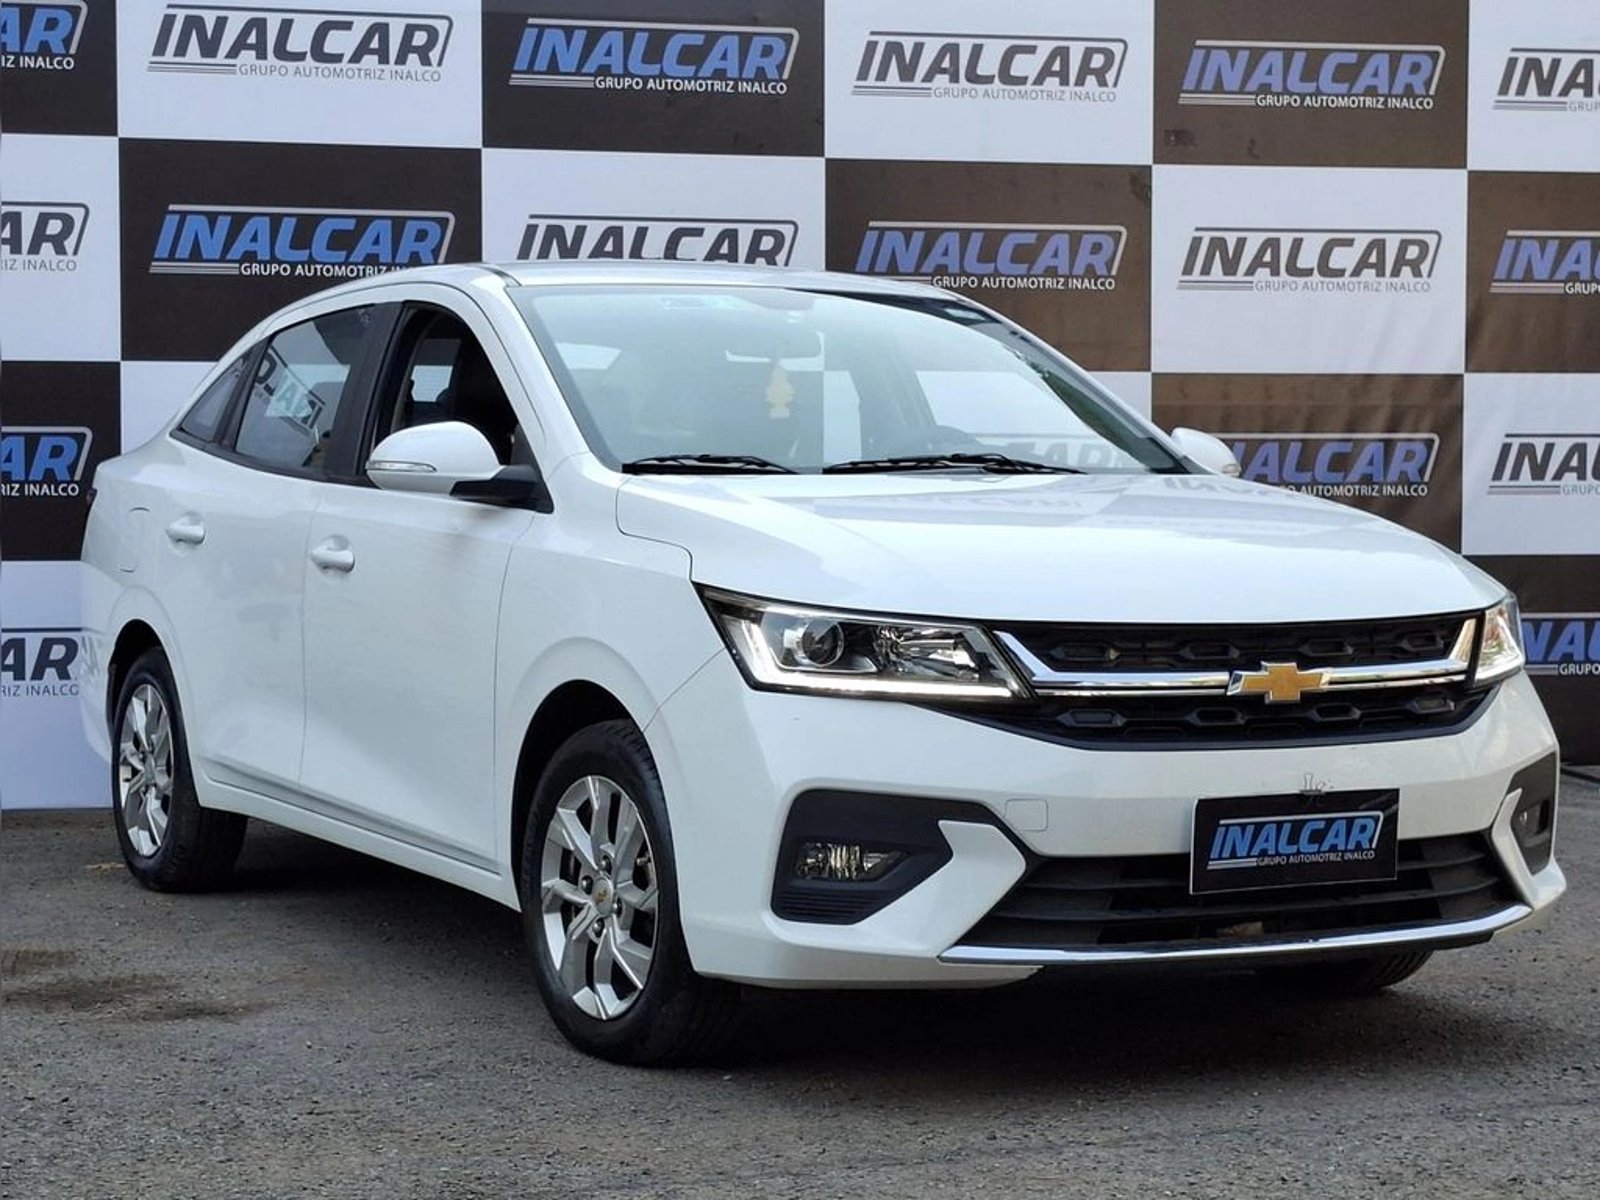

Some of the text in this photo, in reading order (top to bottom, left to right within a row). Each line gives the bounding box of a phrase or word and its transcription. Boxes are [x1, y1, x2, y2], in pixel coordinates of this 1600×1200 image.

[151, 13, 440, 67] INALCAR
[513, 27, 787, 80] INALCAR
[19, 56, 75, 70] INALCO
[856, 40, 1116, 88] INALCAR
[1182, 49, 1434, 95] INALCAR
[238, 63, 442, 82] GRUPO AUTOMOTRIZ INALCO
[1497, 56, 1600, 98] INA
[595, 76, 787, 95] GRUPO AUTOMOTRIZ INALCO
[933, 87, 1117, 102] GRUPO AUTOMOTRIZ INALCO
[1256, 94, 1434, 110] GRUPO AUTOMOTRIZ INALCO
[153, 213, 441, 264] INALCAR
[516, 223, 786, 266] INALCAR
[855, 230, 1115, 277] INALCAR
[1181, 236, 1430, 279] INALCAR
[1, 258, 77, 272] IZ INALCO
[240, 263, 291, 276] GRUPO
[294, 263, 388, 278] AUTOMOTRIZ
[932, 275, 1116, 291] GRUPO AUTOMOTRIZ INALCO
[1254, 279, 1431, 293] GRUPO AUTOMOTRIZ INALCO
[1565, 282, 1600, 295] GRUP
[1232, 440, 1428, 483] ALCAR
[24, 483, 79, 497] INALCO
[1300, 484, 1380, 497] AUTOMOTRIZ
[1382, 484, 1428, 497] INALCO
[1559, 663, 1600, 675] GRUPO
[26, 684, 79, 697] INALCO
[1210, 817, 1376, 859] INALCAR
[1257, 849, 1375, 867] GRUPO AUTOMOTRIZ INALCO
